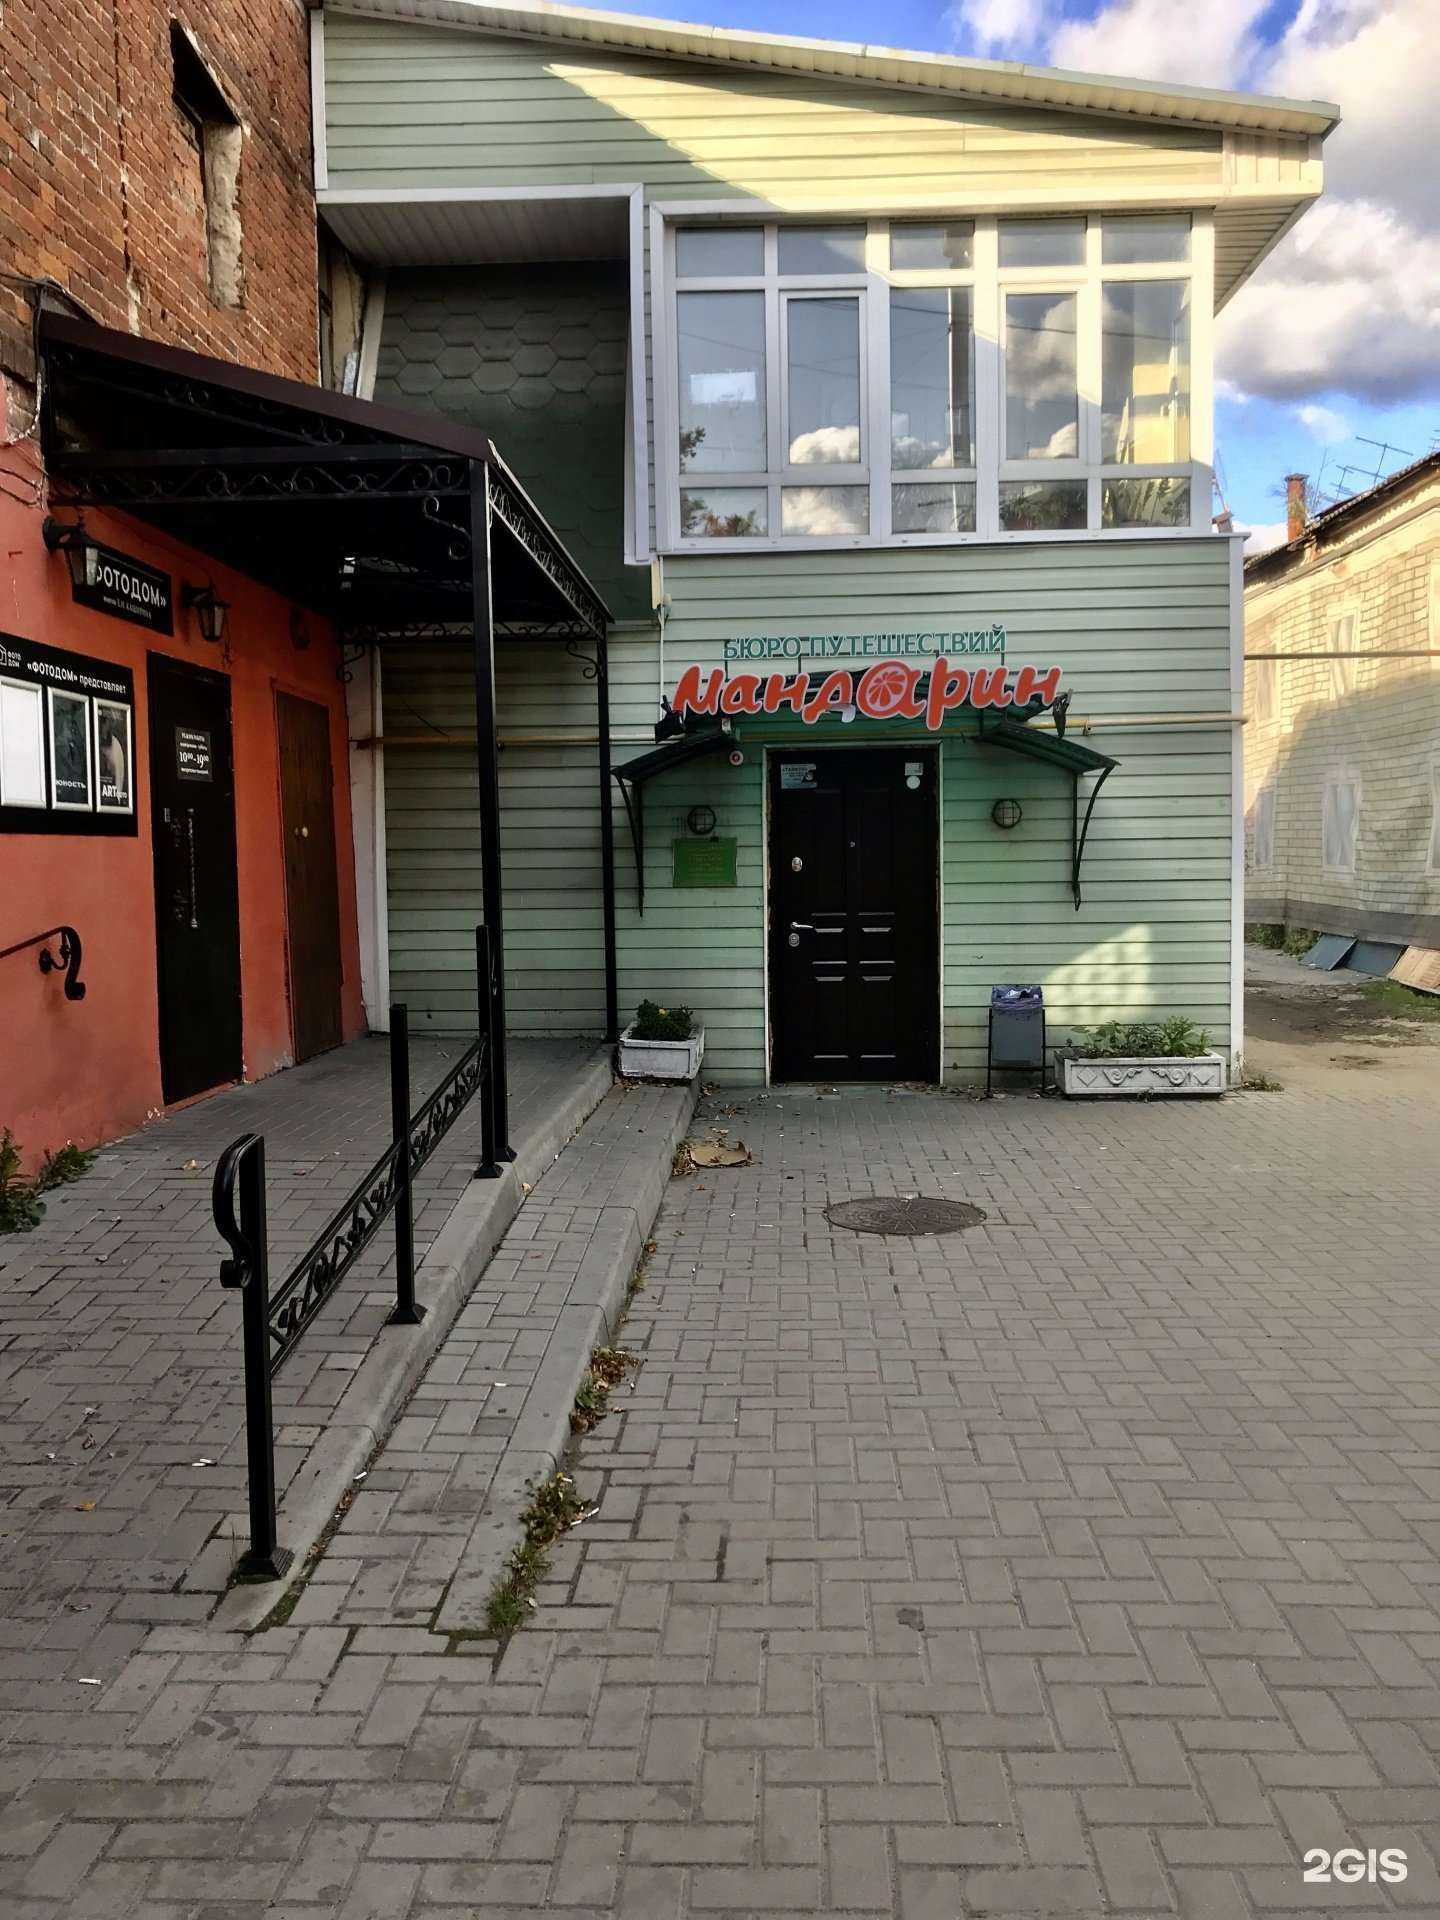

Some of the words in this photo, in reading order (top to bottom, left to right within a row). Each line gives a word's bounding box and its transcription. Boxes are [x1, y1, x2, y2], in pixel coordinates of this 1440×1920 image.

[722, 635, 802, 660] БЮРО
[808, 623, 1008, 658] ПУТЕШЕСТВИЙ
[27, 661, 78, 682] «ФОТОДОМ»
[79, 674, 126, 694] представляет
